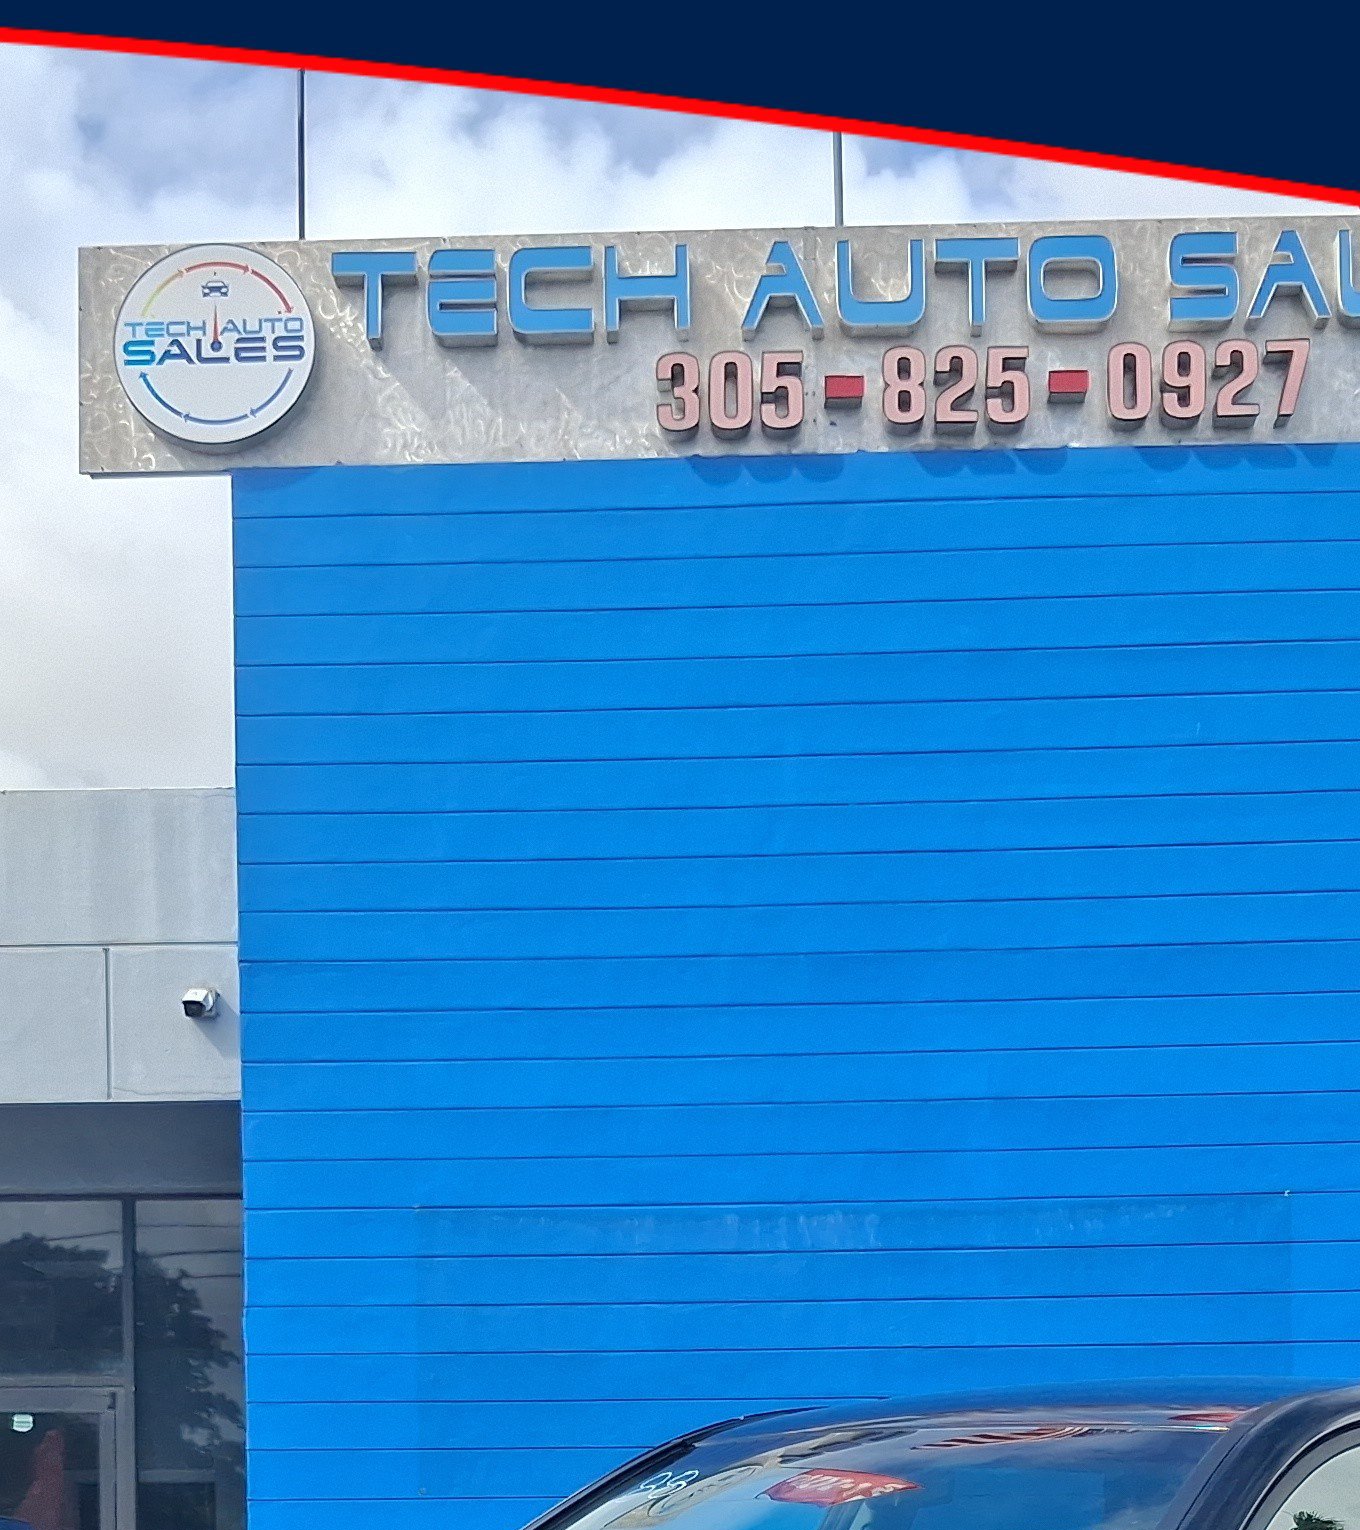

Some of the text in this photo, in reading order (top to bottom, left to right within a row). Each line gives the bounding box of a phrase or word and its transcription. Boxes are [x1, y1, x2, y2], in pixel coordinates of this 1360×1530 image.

[331, 244, 691, 350] TECH
[741, 234, 1118, 340] AUTO
[123, 335, 306, 366] SALES
[124, 317, 305, 339] TECH AUTO
[656, 338, 1312, 434] 305-825-0927
